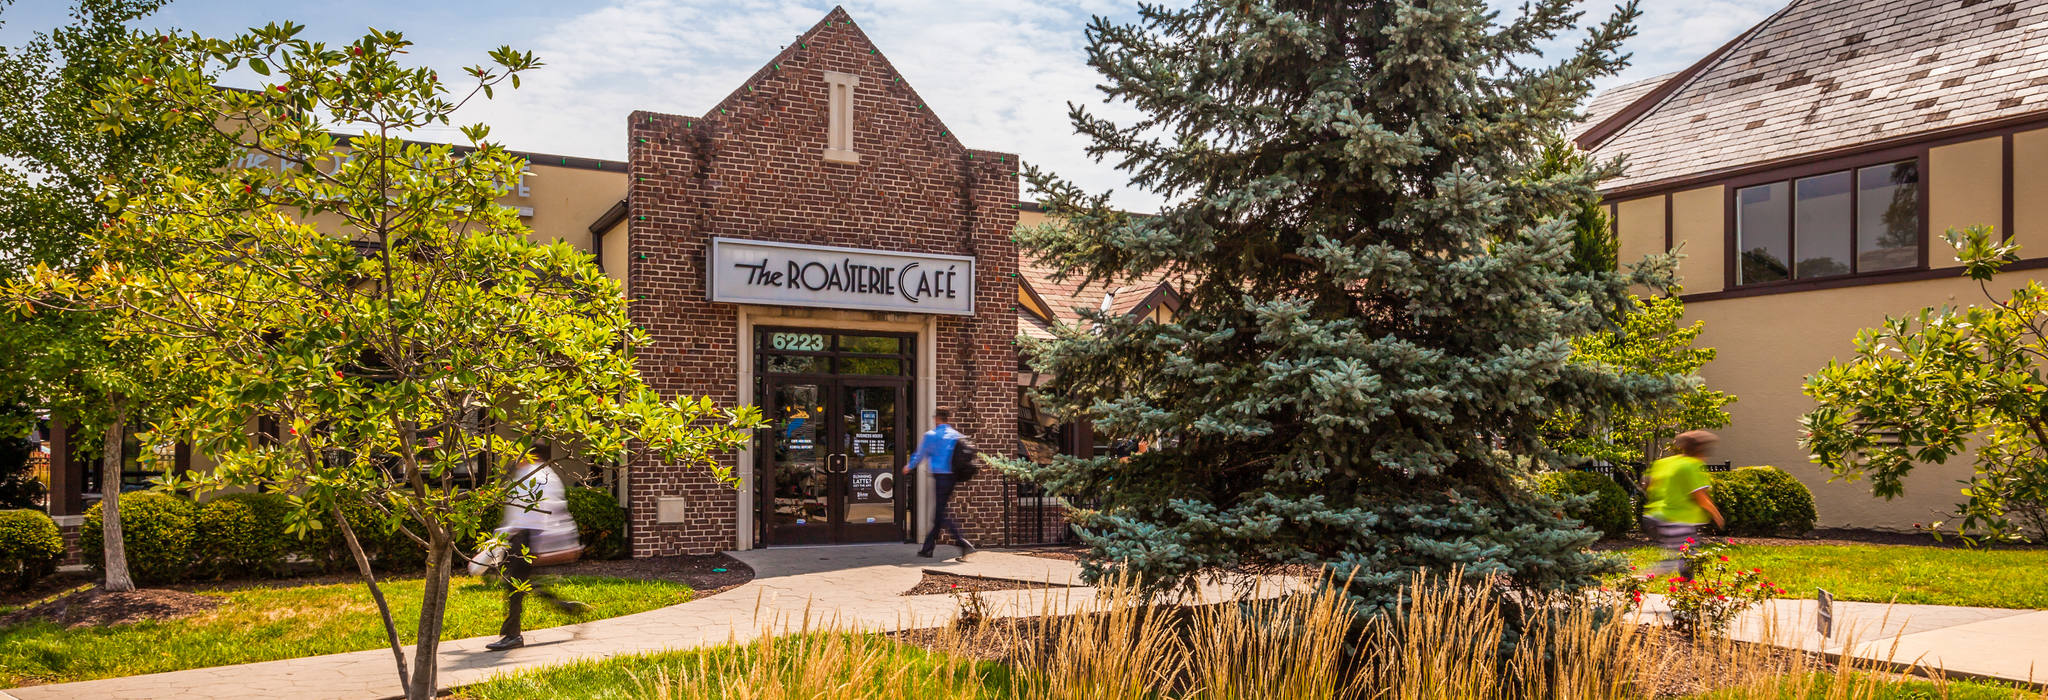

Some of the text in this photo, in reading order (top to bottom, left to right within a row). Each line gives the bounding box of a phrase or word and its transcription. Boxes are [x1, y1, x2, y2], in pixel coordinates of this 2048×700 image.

[734, 257, 956, 304] The ROASTERIE CAFÉ
[772, 332, 824, 351] 6223
